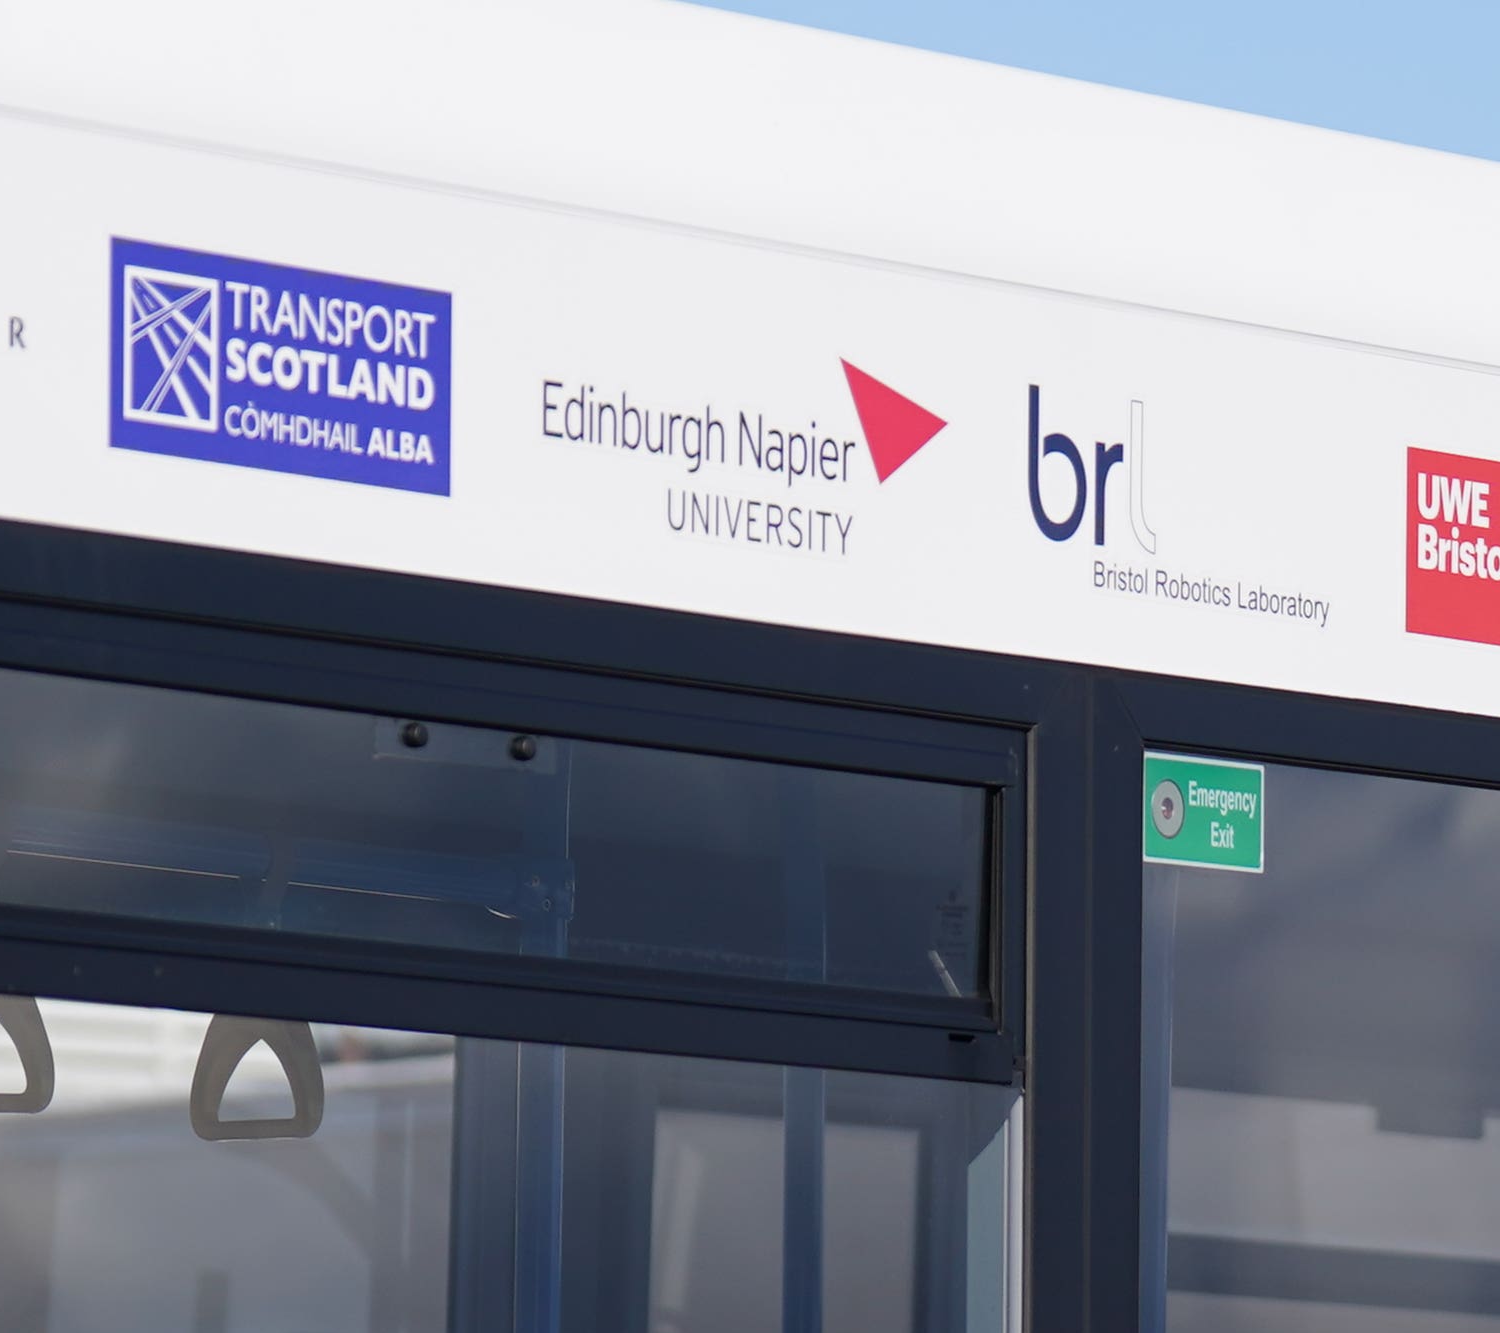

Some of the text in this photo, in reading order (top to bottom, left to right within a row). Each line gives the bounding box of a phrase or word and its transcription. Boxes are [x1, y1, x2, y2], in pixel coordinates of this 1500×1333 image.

[225, 279, 436, 360] TRANSPORT
[225, 337, 435, 412] SCOTLAND
[223, 400, 435, 466] CÒMHDHAIL ALBA
[541, 378, 856, 487] Edinburgh Napier
[1028, 384, 1157, 555] brl
[1416, 471, 1491, 529] UWE
[666, 487, 854, 556] UNIVERSITY
[1092, 560, 1331, 628] Bristol Robotics Laboratory
[1188, 780, 1257, 819] Emergency
[1210, 821, 1235, 849] Exit
